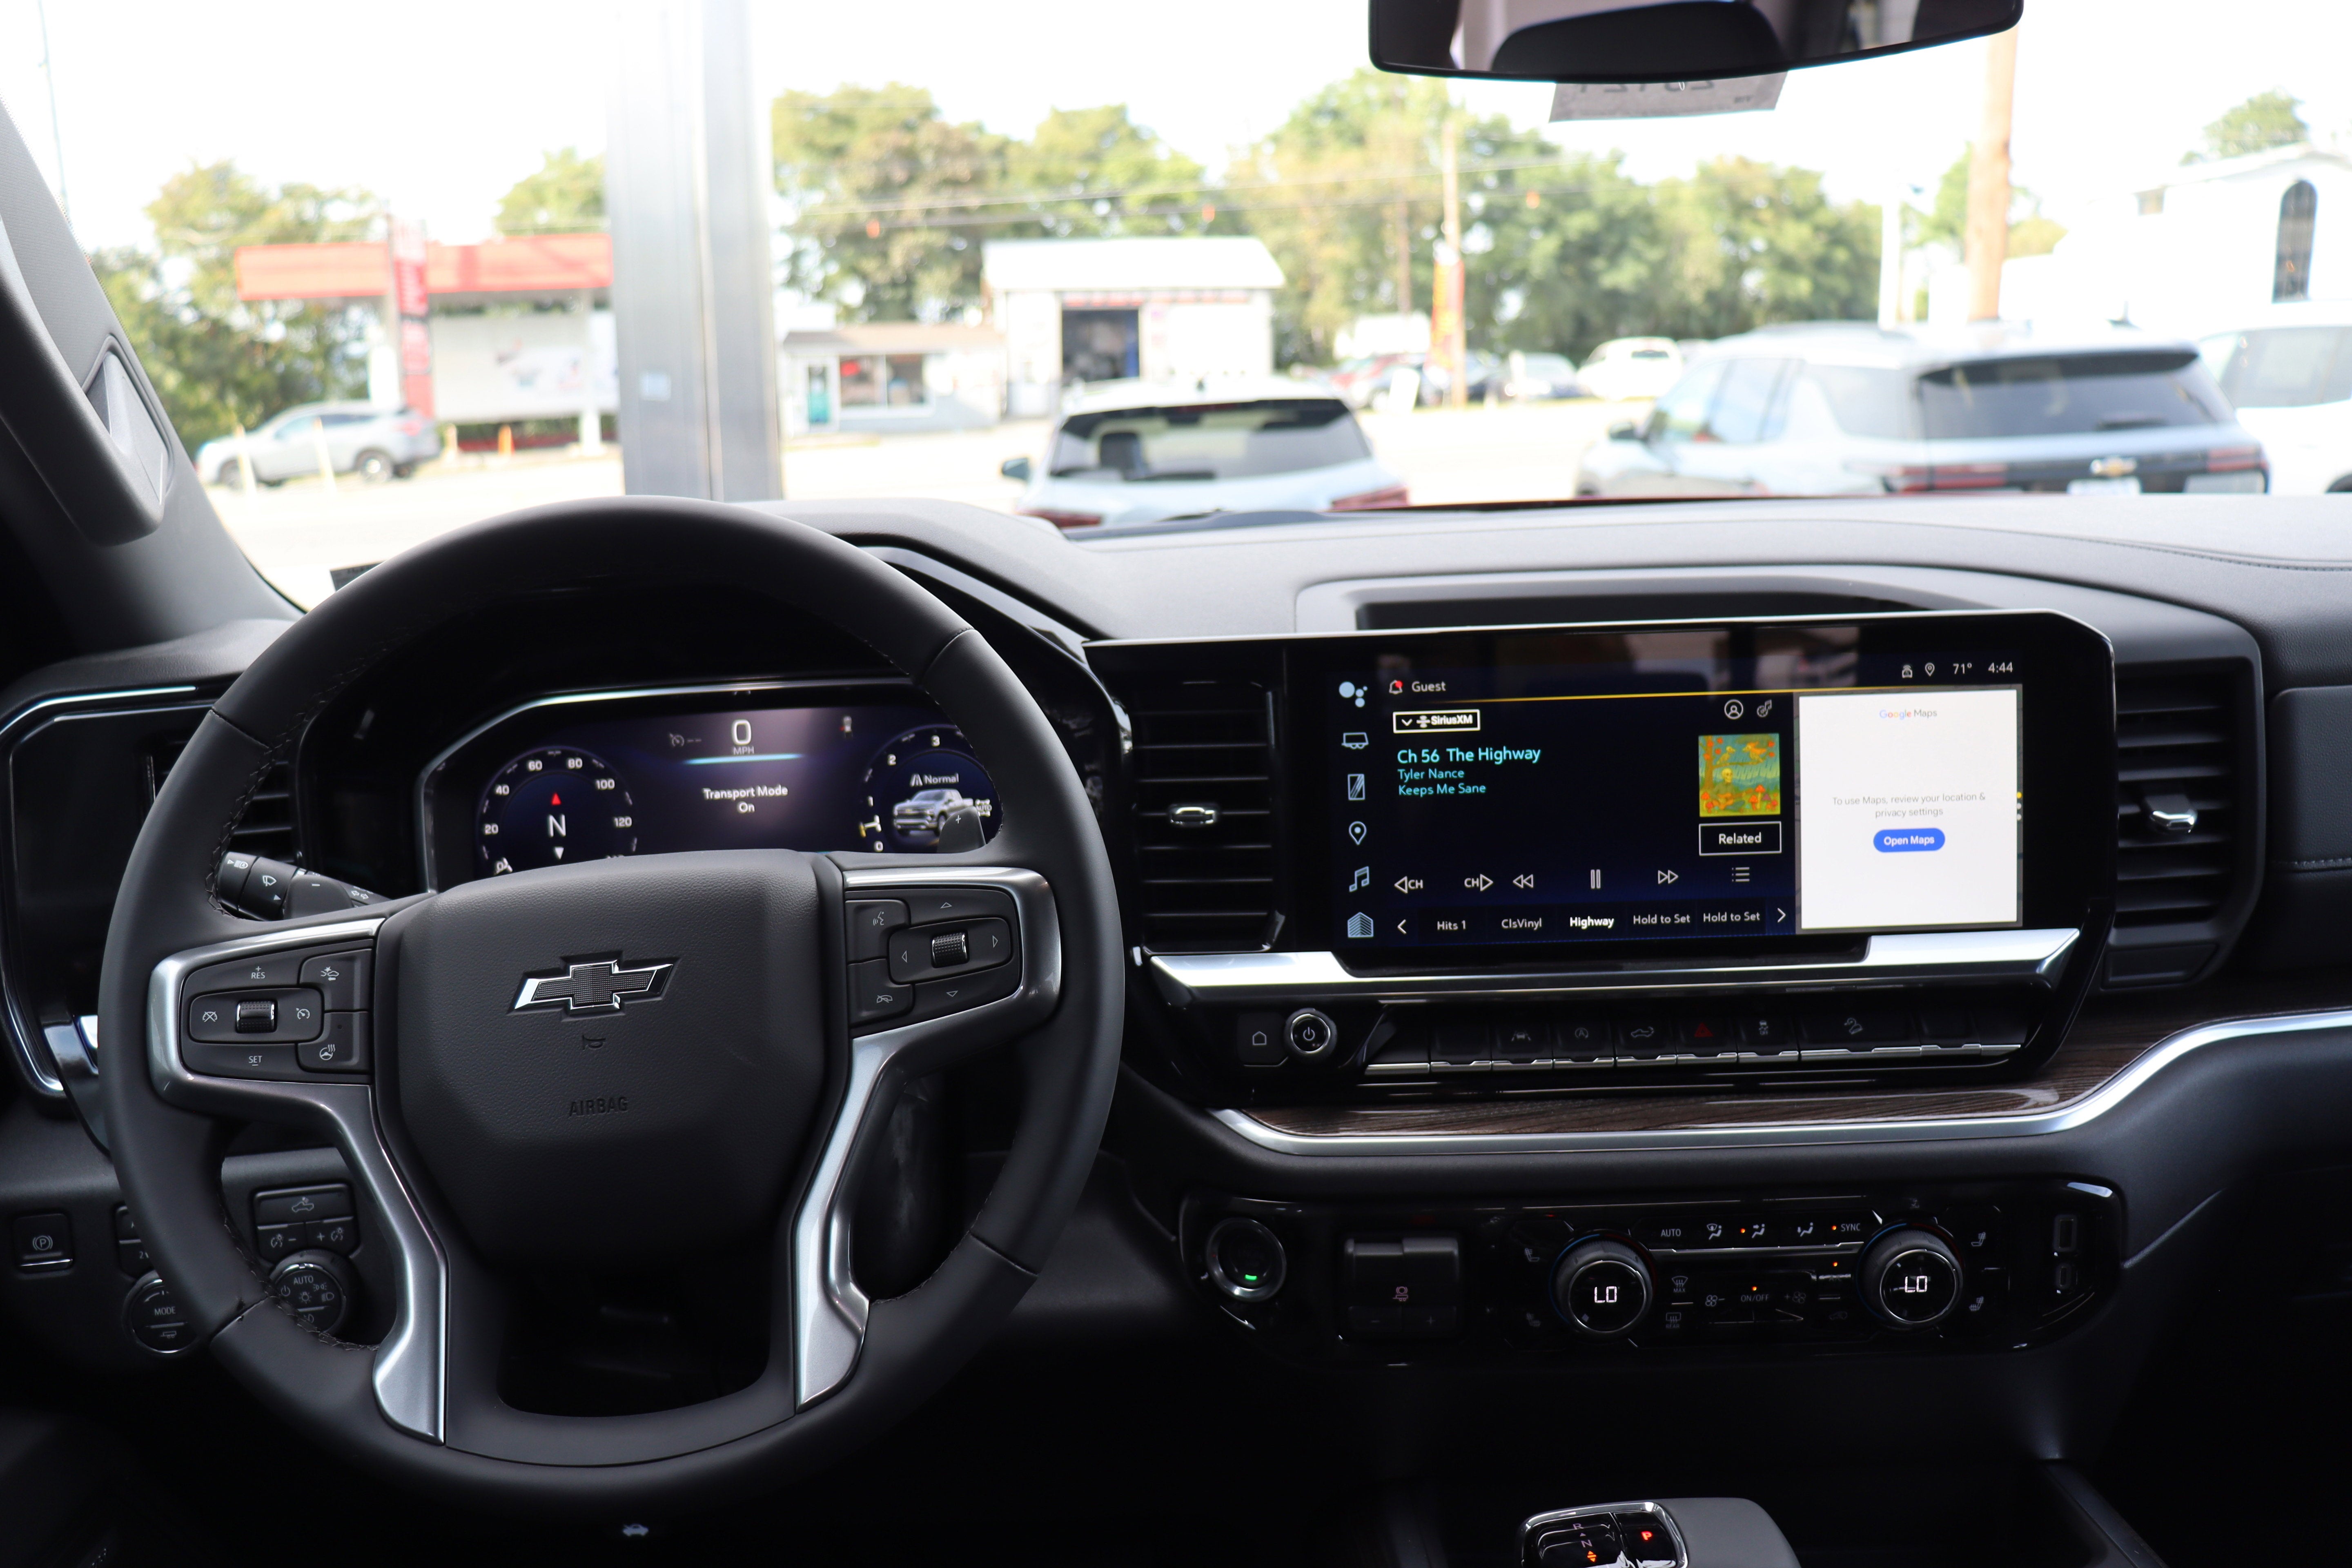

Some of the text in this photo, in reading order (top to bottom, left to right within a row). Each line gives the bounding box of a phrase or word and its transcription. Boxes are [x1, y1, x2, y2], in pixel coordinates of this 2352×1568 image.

[1988, 662, 2013, 673] 4:44
[1411, 680, 1446, 693] Guest
[1879, 708, 1938, 720] Google Maps
[1431, 714, 1473, 726] SiriusXM
[731, 719, 752, 746] 0
[932, 735, 940, 747] 3
[733, 746, 755, 755] MPH
[1397, 746, 1541, 766] Ch 56 The Highway
[568, 758, 583, 768] 80
[888, 754, 897, 765] 2
[528, 760, 543, 771] 60
[924, 772, 960, 786] Normal
[1397, 768, 1465, 782] Tyler Nance
[495, 784, 510, 795] 40
[595, 779, 615, 790] 100
[1398, 783, 1486, 797] Keeps Me Sane
[703, 785, 788, 800] Transport Mode
[868, 795, 874, 807] 1
[1833, 797, 1843, 806] To
[1862, 796, 1888, 804] Maps,
[1891, 794, 1920, 803] review
[1920, 795, 1940, 803] your
[1942, 792, 1978, 802] location
[1979, 792, 1986, 800] &
[738, 802, 755, 813] On
[1875, 806, 1943, 819] privacy settings
[548, 814, 567, 837] N
[614, 816, 632, 827] 120
[484, 824, 499, 835] 20
[1718, 832, 1762, 845] Related
[1883, 835, 1935, 847] Open Maps
[874, 841, 884, 851] 0
[1408, 879, 1423, 890] CH
[1464, 878, 1479, 888] CH
[1633, 913, 1690, 925] Hold to Set
[1703, 911, 1760, 922] Hold to Set
[1437, 919, 1466, 931] Hits 1
[1501, 918, 1543, 929] ClsVinyl
[1570, 915, 1615, 930] Highway
[251, 971, 265, 980] RES
[248, 1055, 263, 1063] SET
[570, 1096, 628, 1117] AIRBAG
[1660, 1228, 1682, 1237] AUTO
[1840, 1223, 1861, 1232] SYNC
[293, 1275, 314, 1285] AUTO
[1594, 1285, 1617, 1303] LO
[1741, 1294, 1770, 1302] ON/OFF
[154, 1306, 176, 1316] MODE
[1641, 1530, 1653, 1540] P
[1581, 1540, 1593, 1548] N
